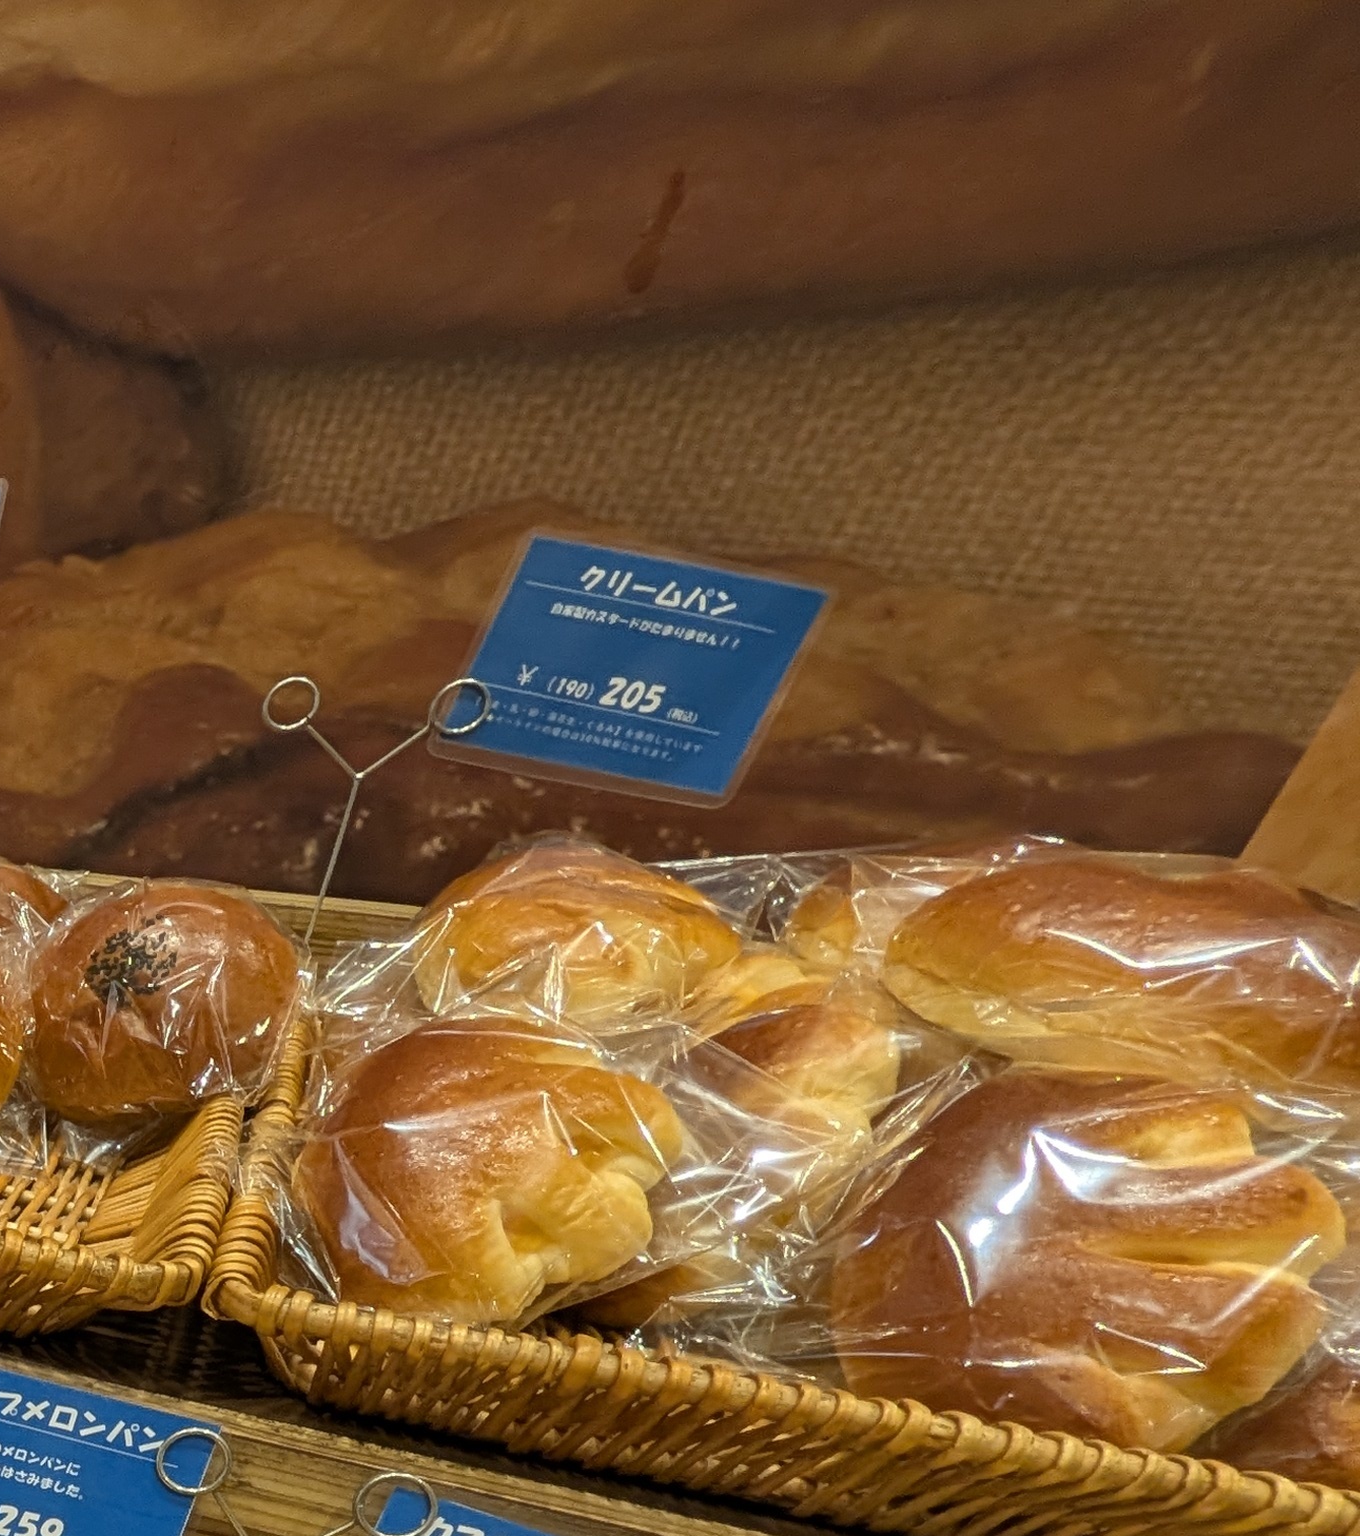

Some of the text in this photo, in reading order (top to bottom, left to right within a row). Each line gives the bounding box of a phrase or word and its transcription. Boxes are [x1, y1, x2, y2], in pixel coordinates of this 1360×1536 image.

[580, 564, 737, 617] クリームパン
[517, 663, 539, 686] ¥
[547, 676, 595, 701] (190)
[599, 676, 667, 714] 205
